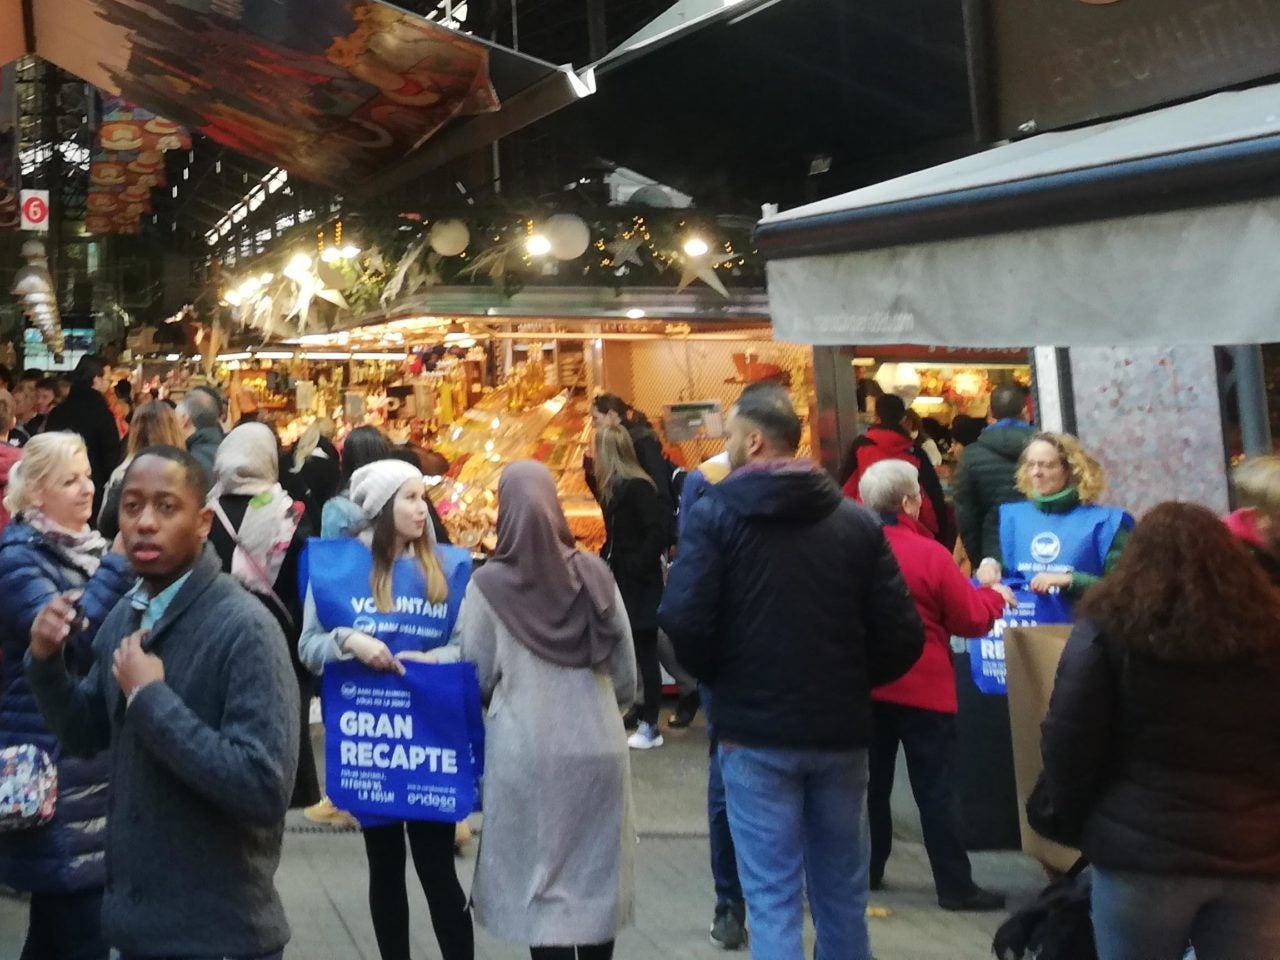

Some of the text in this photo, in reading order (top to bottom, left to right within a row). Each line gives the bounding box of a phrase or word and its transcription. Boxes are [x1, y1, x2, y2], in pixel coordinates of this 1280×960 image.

[28, 200, 42, 220] 6
[351, 595, 449, 619] VOUNTARI
[340, 710, 413, 740] GRAN
[340, 740, 458, 774] RECAPTE
